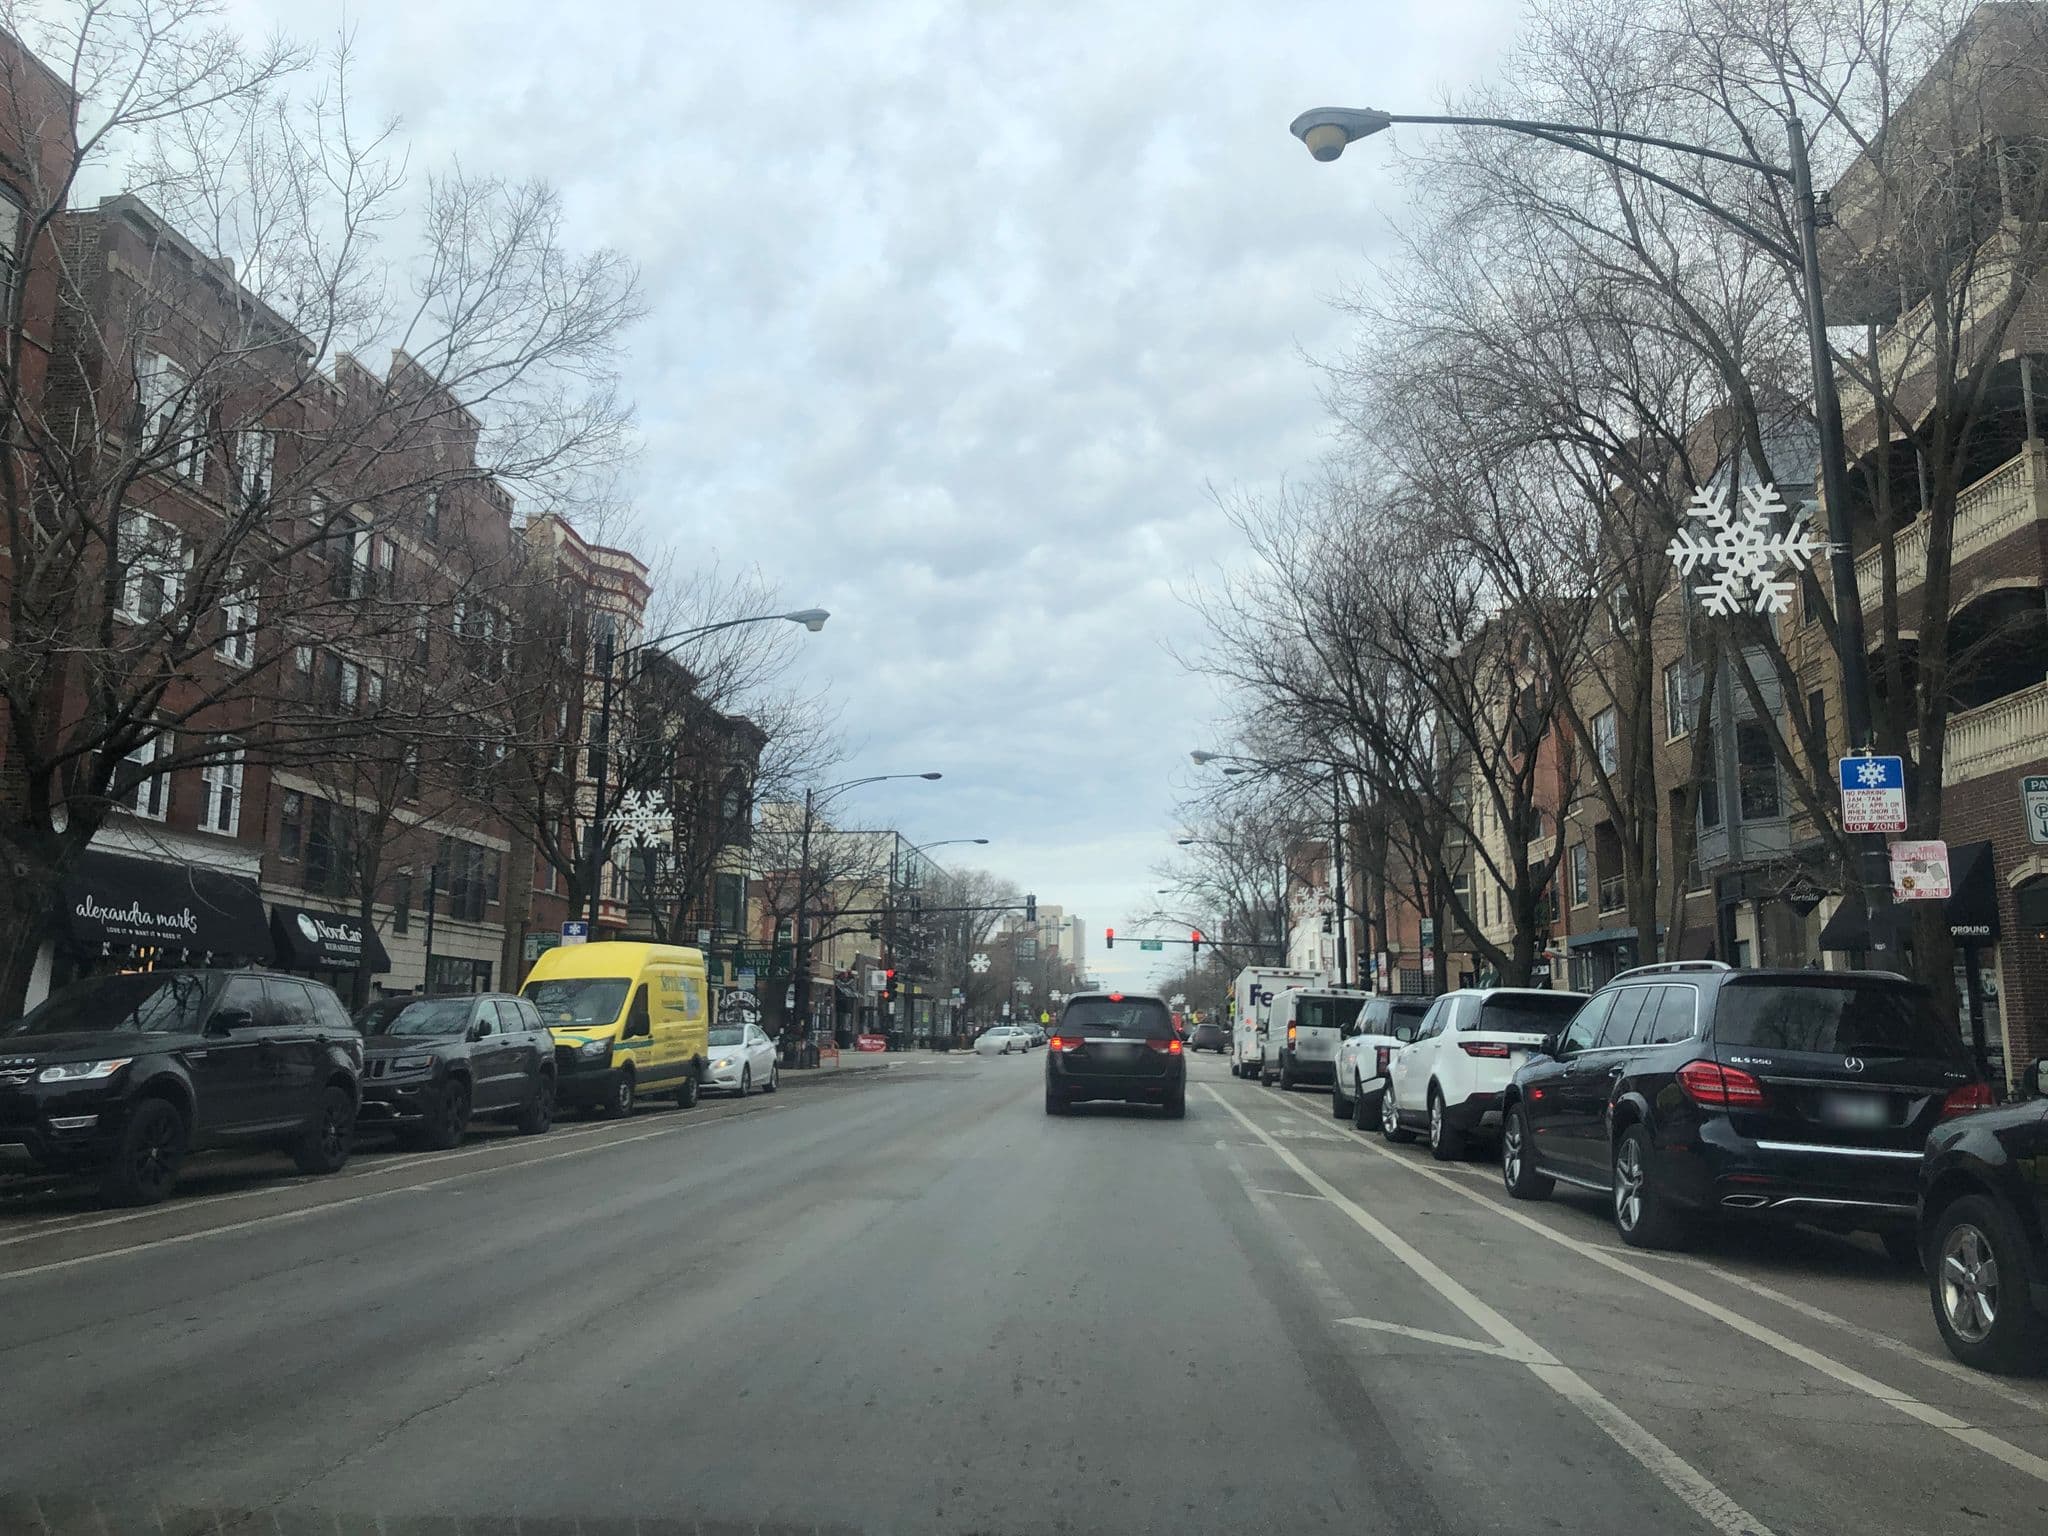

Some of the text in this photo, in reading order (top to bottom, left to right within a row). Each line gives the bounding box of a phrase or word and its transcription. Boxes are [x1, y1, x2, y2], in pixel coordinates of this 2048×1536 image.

[1848, 822, 1901, 831] TOW ZONE
[1921, 888, 1943, 896] ZONE
[76, 894, 198, 933] alexandra marks
[314, 919, 362, 942] NovaCar
